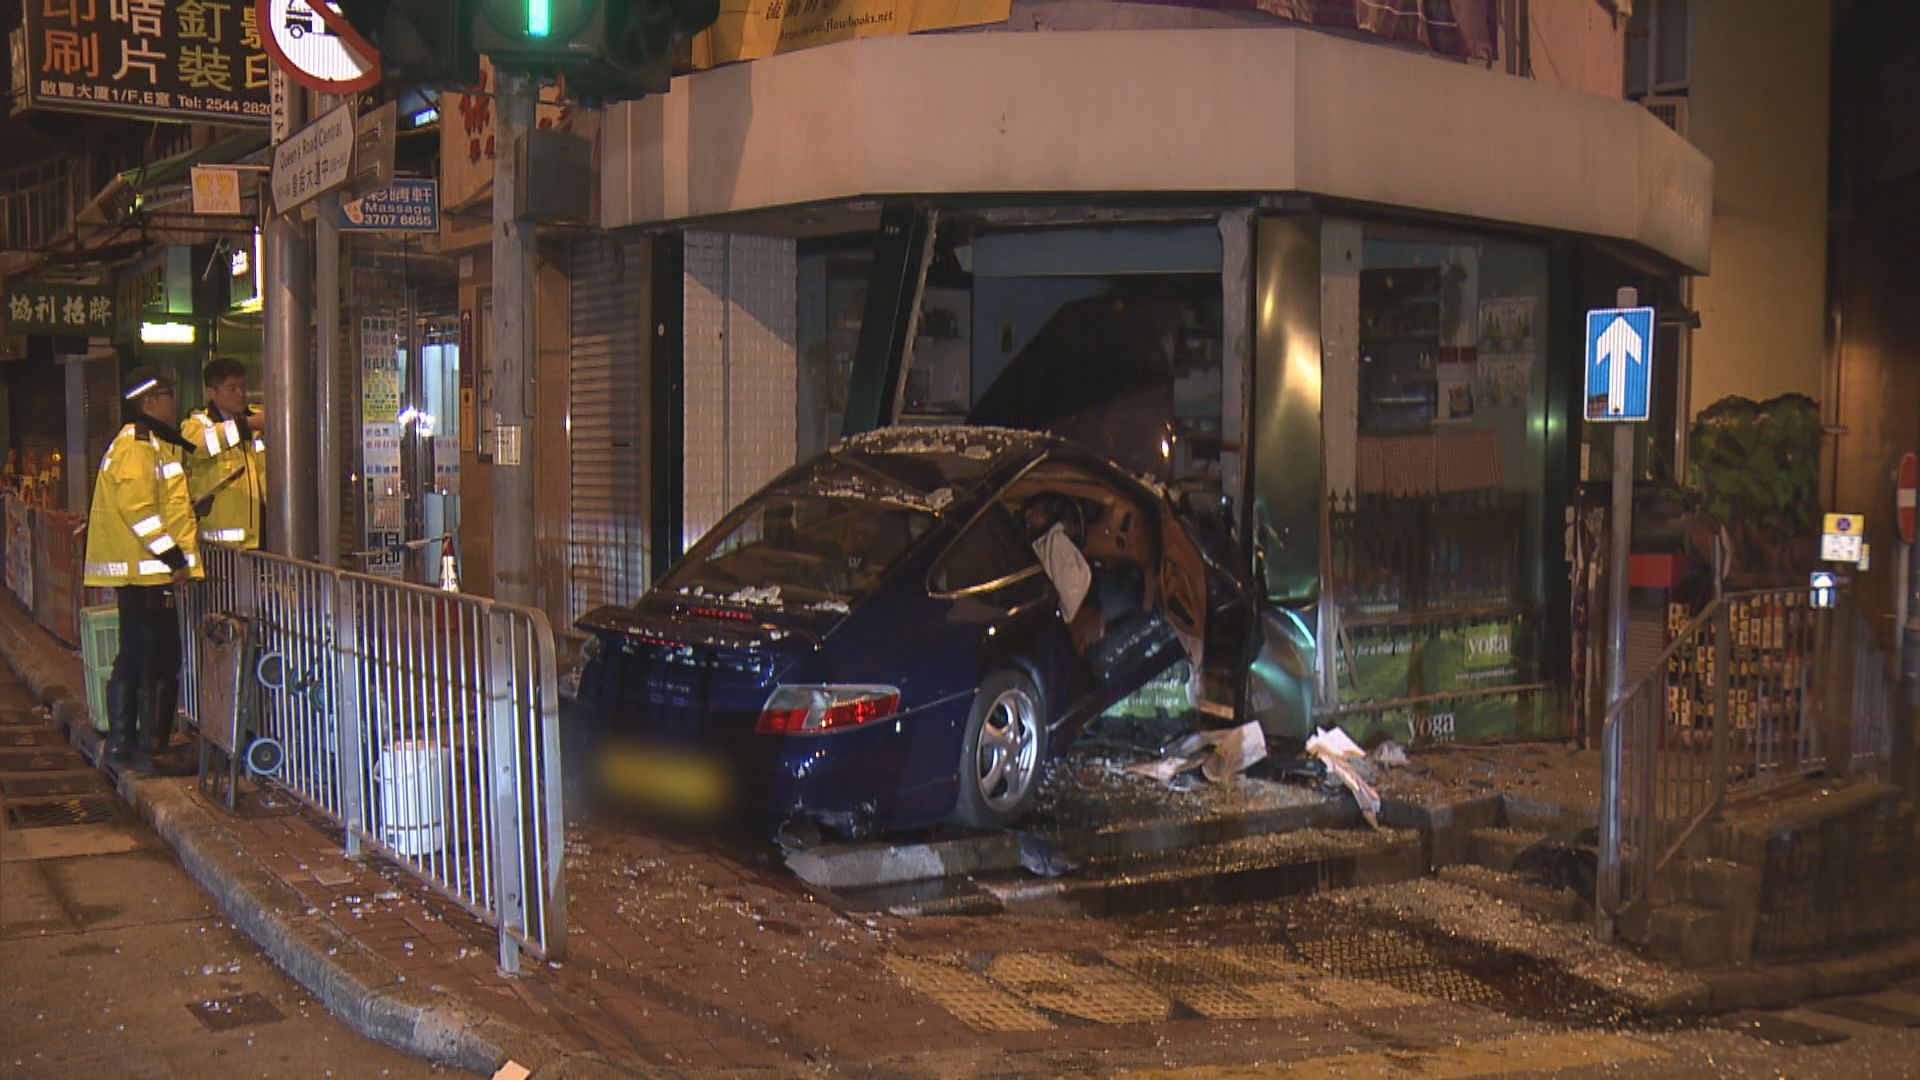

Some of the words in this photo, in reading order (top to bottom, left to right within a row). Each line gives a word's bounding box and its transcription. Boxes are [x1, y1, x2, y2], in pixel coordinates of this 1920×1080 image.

[175, 0, 232, 91] 釘裝
[177, 94, 202, 109] Tel:
[206, 97, 239, 112] 2544
[302, 131, 318, 157] Road
[319, 118, 343, 147] Central
[364, 214, 396, 225] 3707
[365, 202, 431, 215] Massage
[1467, 633, 1509, 661] yoga
[1407, 711, 1456, 747] yoga
